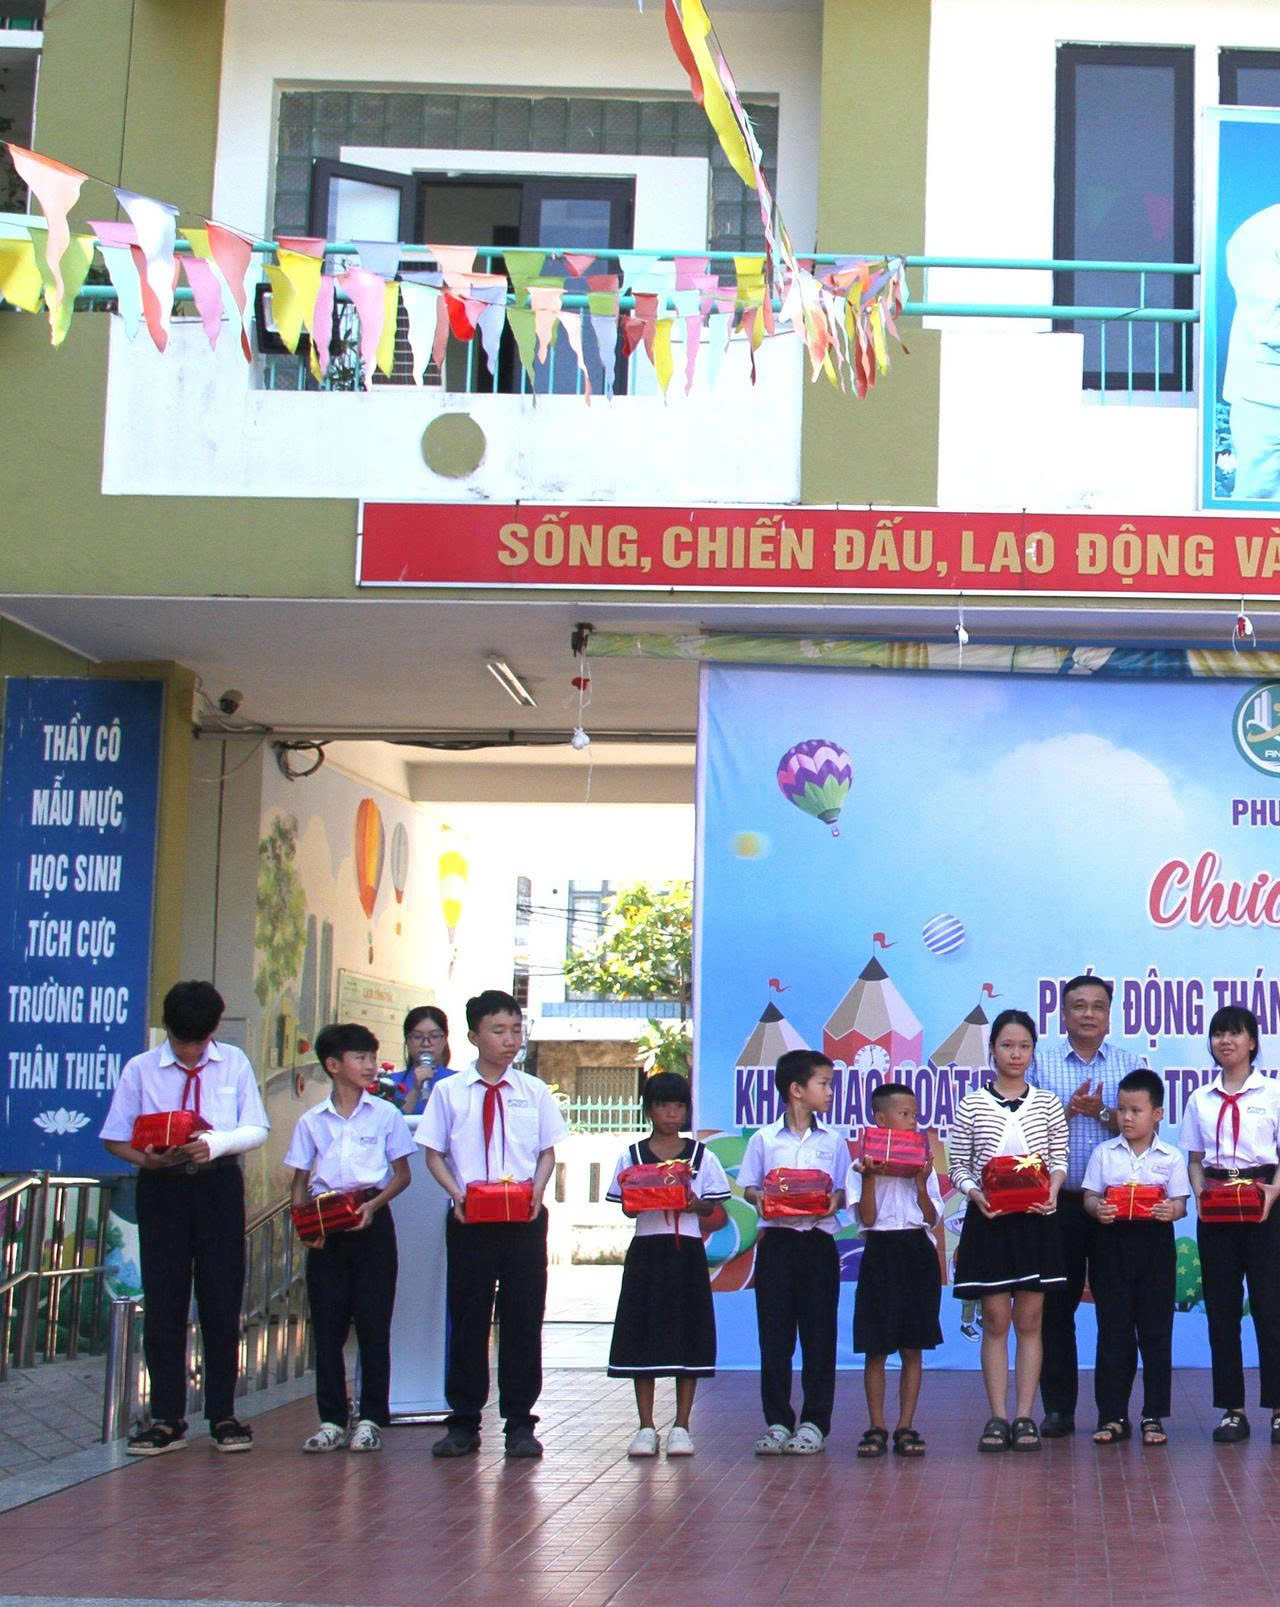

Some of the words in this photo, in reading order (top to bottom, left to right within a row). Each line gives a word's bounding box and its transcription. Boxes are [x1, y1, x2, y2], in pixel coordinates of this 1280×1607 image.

[498, 511, 651, 573] SỐNG,
[662, 512, 813, 571] CHIẾN
[833, 515, 948, 576] ĐẤU,
[961, 531, 1055, 574] LAO
[1075, 523, 1215, 585] ĐỘNG
[43, 712, 91, 761] THẦY
[95, 718, 121, 762] CÔ
[31, 775, 74, 826] MẪU
[78, 786, 123, 834] MỰC
[29, 854, 69, 899] HỌC
[75, 855, 122, 892] SINH
[28, 911, 73, 957] TÍCH
[76, 916, 116, 966] CỰC
[9, 976, 84, 1024] TRƯỜNG
[89, 986, 129, 1032] HỌC
[1123, 969, 1204, 1048] ĐỘNG
[8, 1044, 59, 1089] THÂN
[65, 1044, 121, 1098] THIỆN
